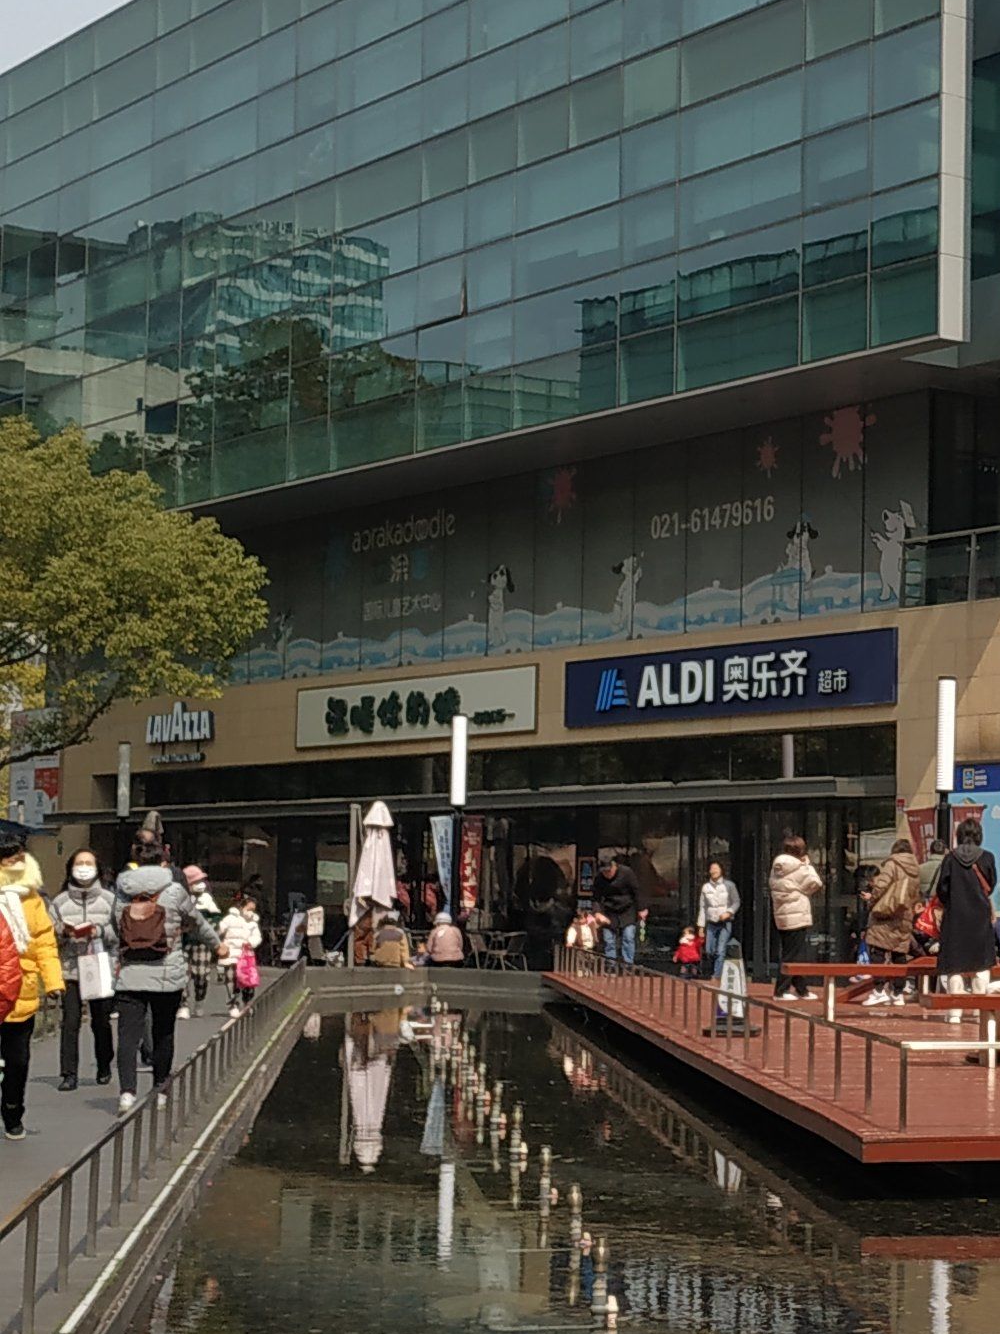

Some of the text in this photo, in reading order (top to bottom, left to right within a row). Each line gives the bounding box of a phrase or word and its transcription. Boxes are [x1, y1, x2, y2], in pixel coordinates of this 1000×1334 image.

[650, 495, 775, 539] 021-61479616
[636, 649, 848, 708] ALDI 奥乐齐 超市
[145, 701, 213, 744] LAVAZZA
